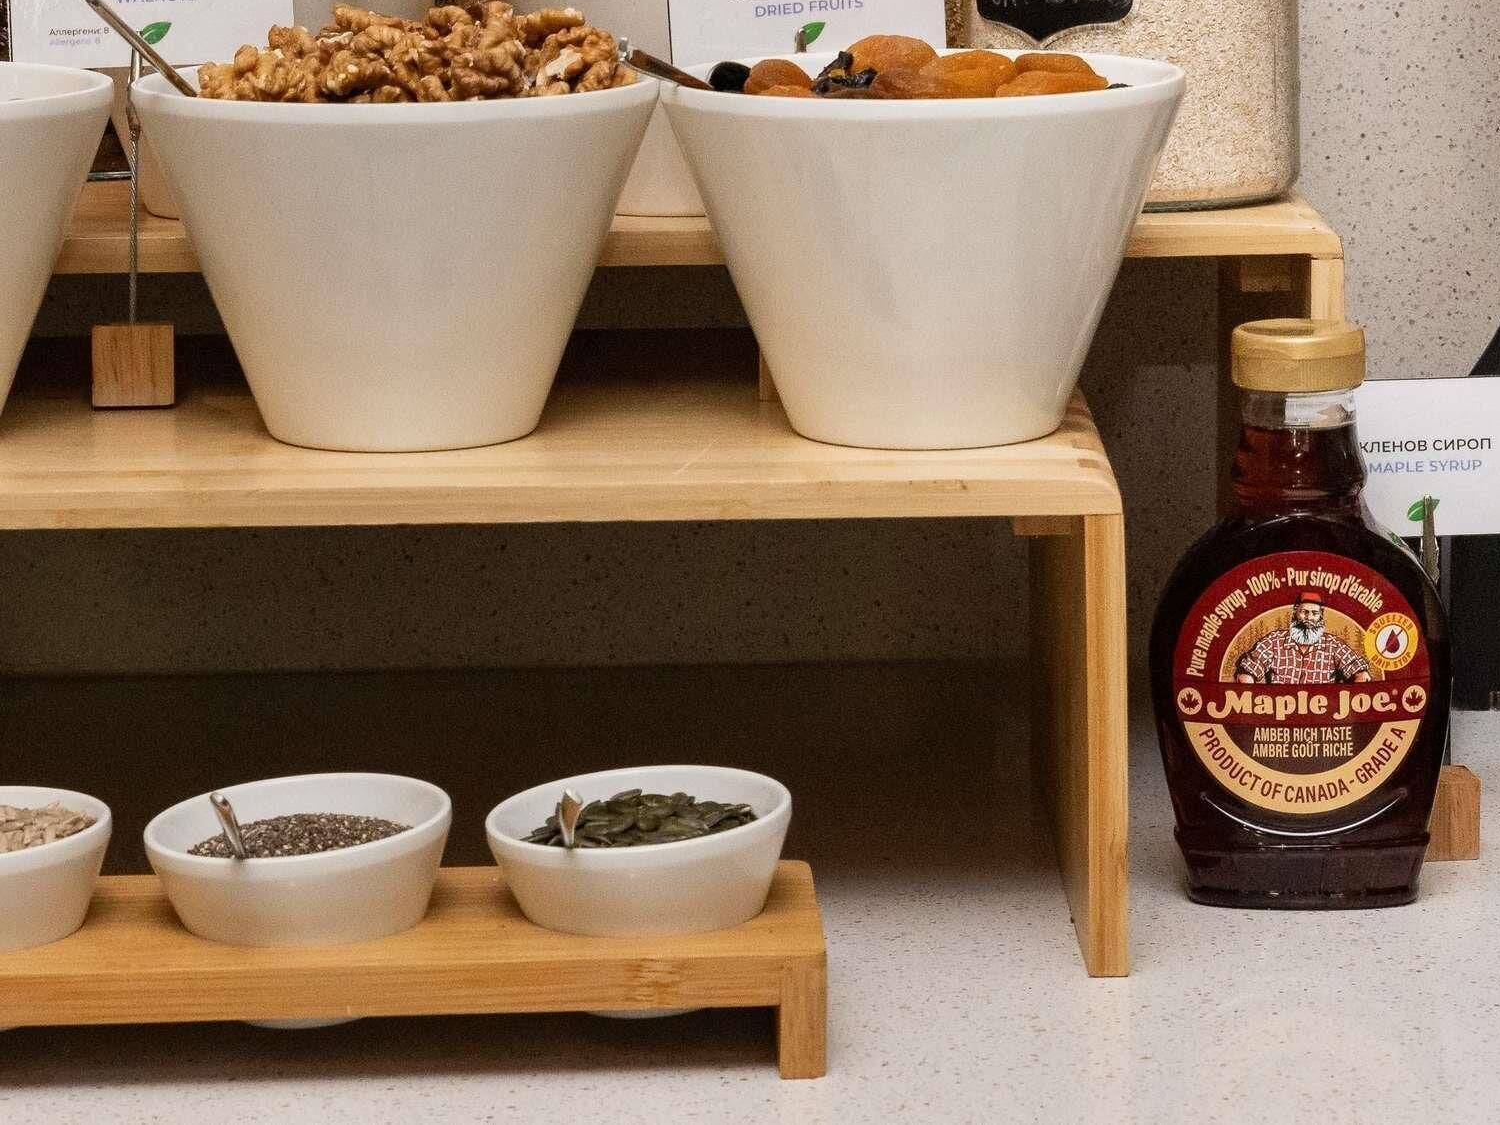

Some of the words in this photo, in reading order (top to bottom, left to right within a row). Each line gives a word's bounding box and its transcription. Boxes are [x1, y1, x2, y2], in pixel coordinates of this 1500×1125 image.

[754, 2, 804, 18] DRIED
[1360, 439, 1428, 453] КЛЕНОВ
[1433, 437, 1492, 451] СИРОП
[1369, 460, 1424, 473] MAPLE
[1429, 459, 1483, 472] SYRUP
[1186, 648, 1207, 678] Pure
[1197, 613, 1224, 652] maple
[1214, 588, 1248, 621] syrup
[1246, 570, 1281, 597] 100%
[1286, 567, 1310, 587] Pur
[1309, 566, 1341, 594] sirop
[1206, 689, 1328, 721] Maple
[1332, 689, 1398, 720] Joe
[1253, 727, 1291, 742] AMBER
[1293, 727, 1319, 742] RICH
[1321, 726, 1353, 741] TASTE
[1252, 739, 1290, 758] AMBRÉ
[1291, 740, 1321, 758] GOÛT
[1322, 742, 1354, 757] RICHE
[1199, 727, 1263, 792] PRODUCT
[1260, 779, 1283, 800] OF
[1284, 778, 1350, 804] CANADA
[1354, 738, 1399, 785] GRADE
[1392, 727, 1407, 741] A
